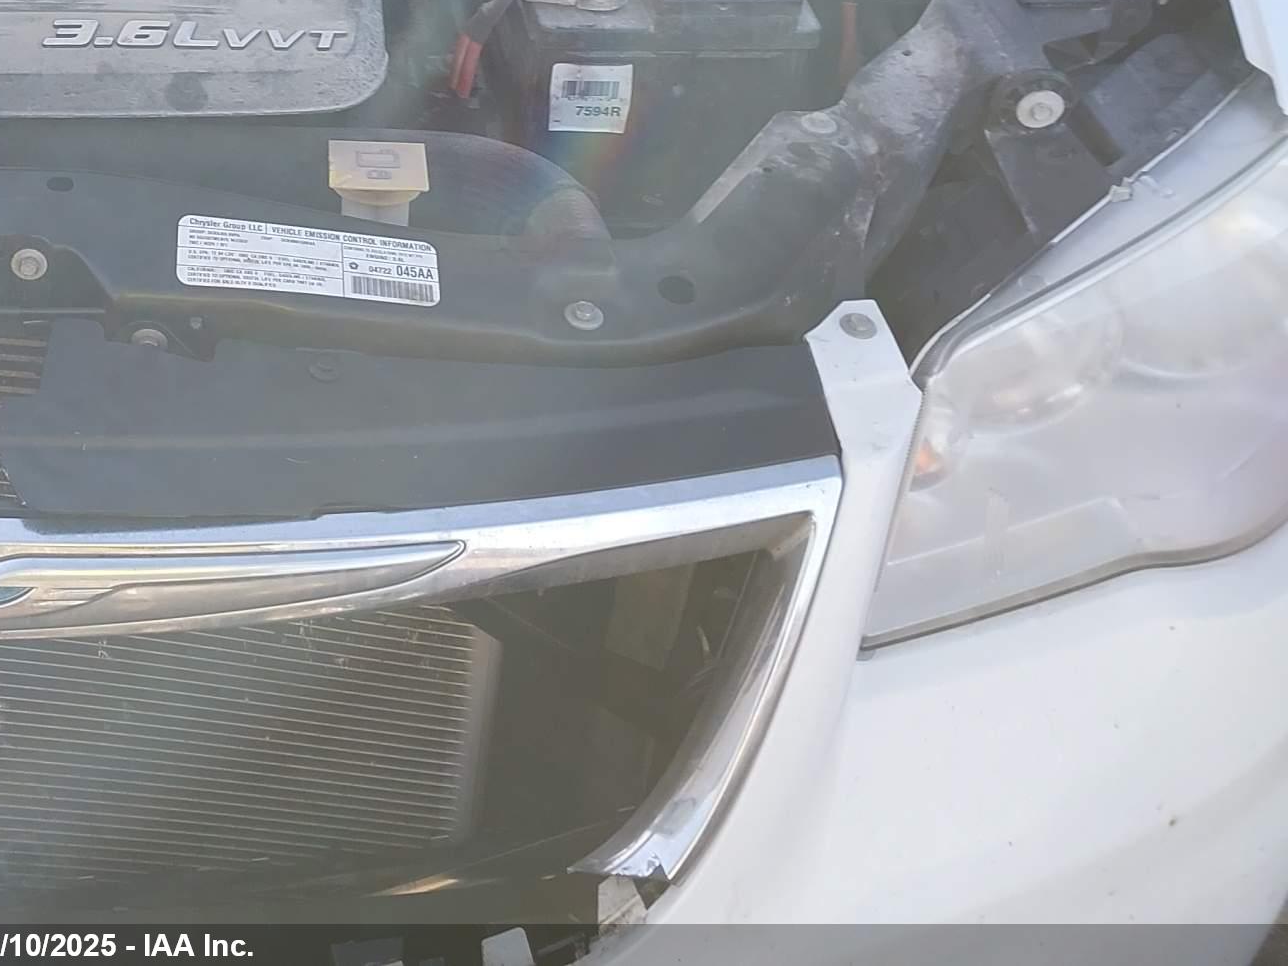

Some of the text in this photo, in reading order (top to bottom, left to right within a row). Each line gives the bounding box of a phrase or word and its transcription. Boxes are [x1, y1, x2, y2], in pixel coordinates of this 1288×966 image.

[41, 19, 348, 51] 3.6L VVT
[575, 105, 622, 117] 7594R
[189, 217, 263, 232] Chrysler Group LLC
[271, 227, 302, 237] VEHICLE
[305, 231, 341, 241] EMISSION
[343, 235, 378, 245] CONTROL
[379, 240, 432, 252] INFORMATION
[368, 265, 434, 280] 04722 045AA
